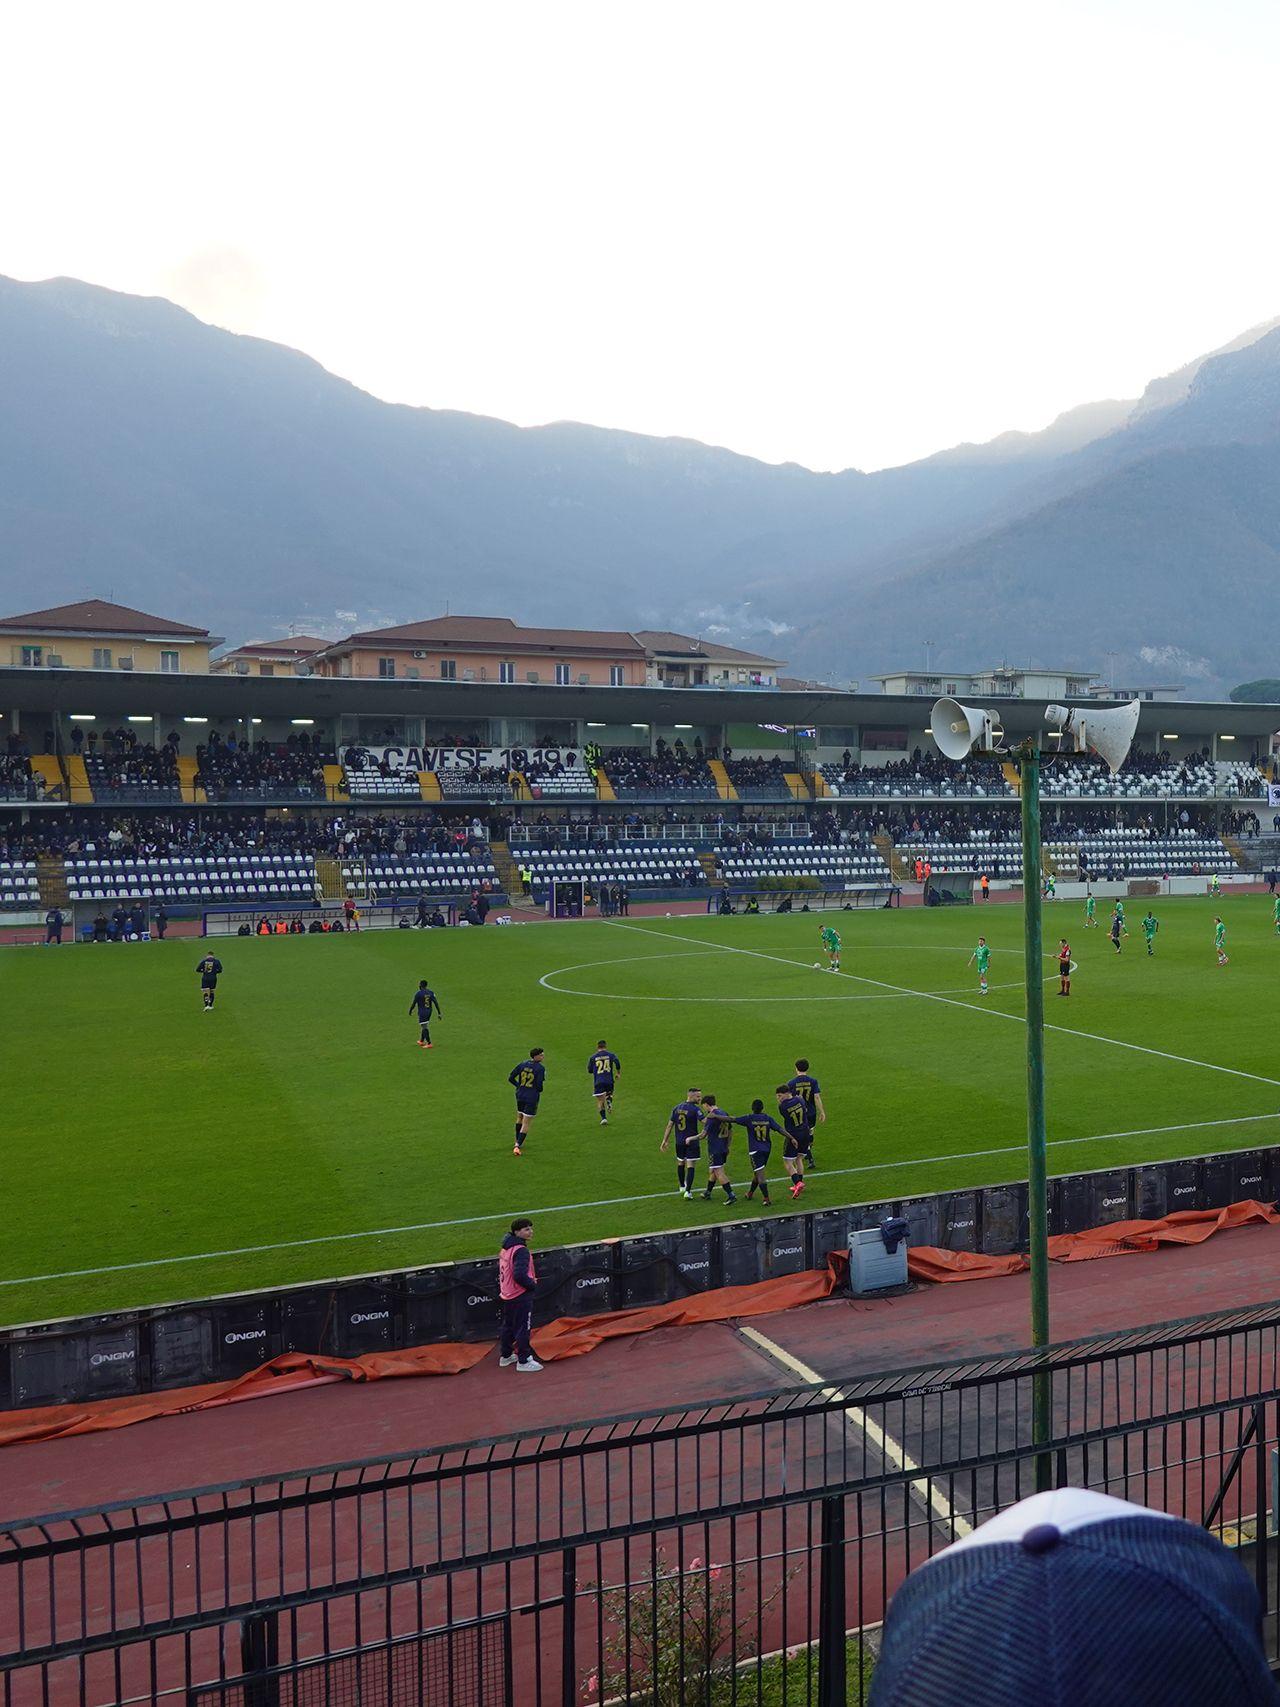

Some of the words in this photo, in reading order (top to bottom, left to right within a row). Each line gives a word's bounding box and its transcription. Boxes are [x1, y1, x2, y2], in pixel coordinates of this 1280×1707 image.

[595, 1059, 610, 1074] 24
[678, 1113, 686, 1131] 3
[754, 1125, 767, 1141] 11
